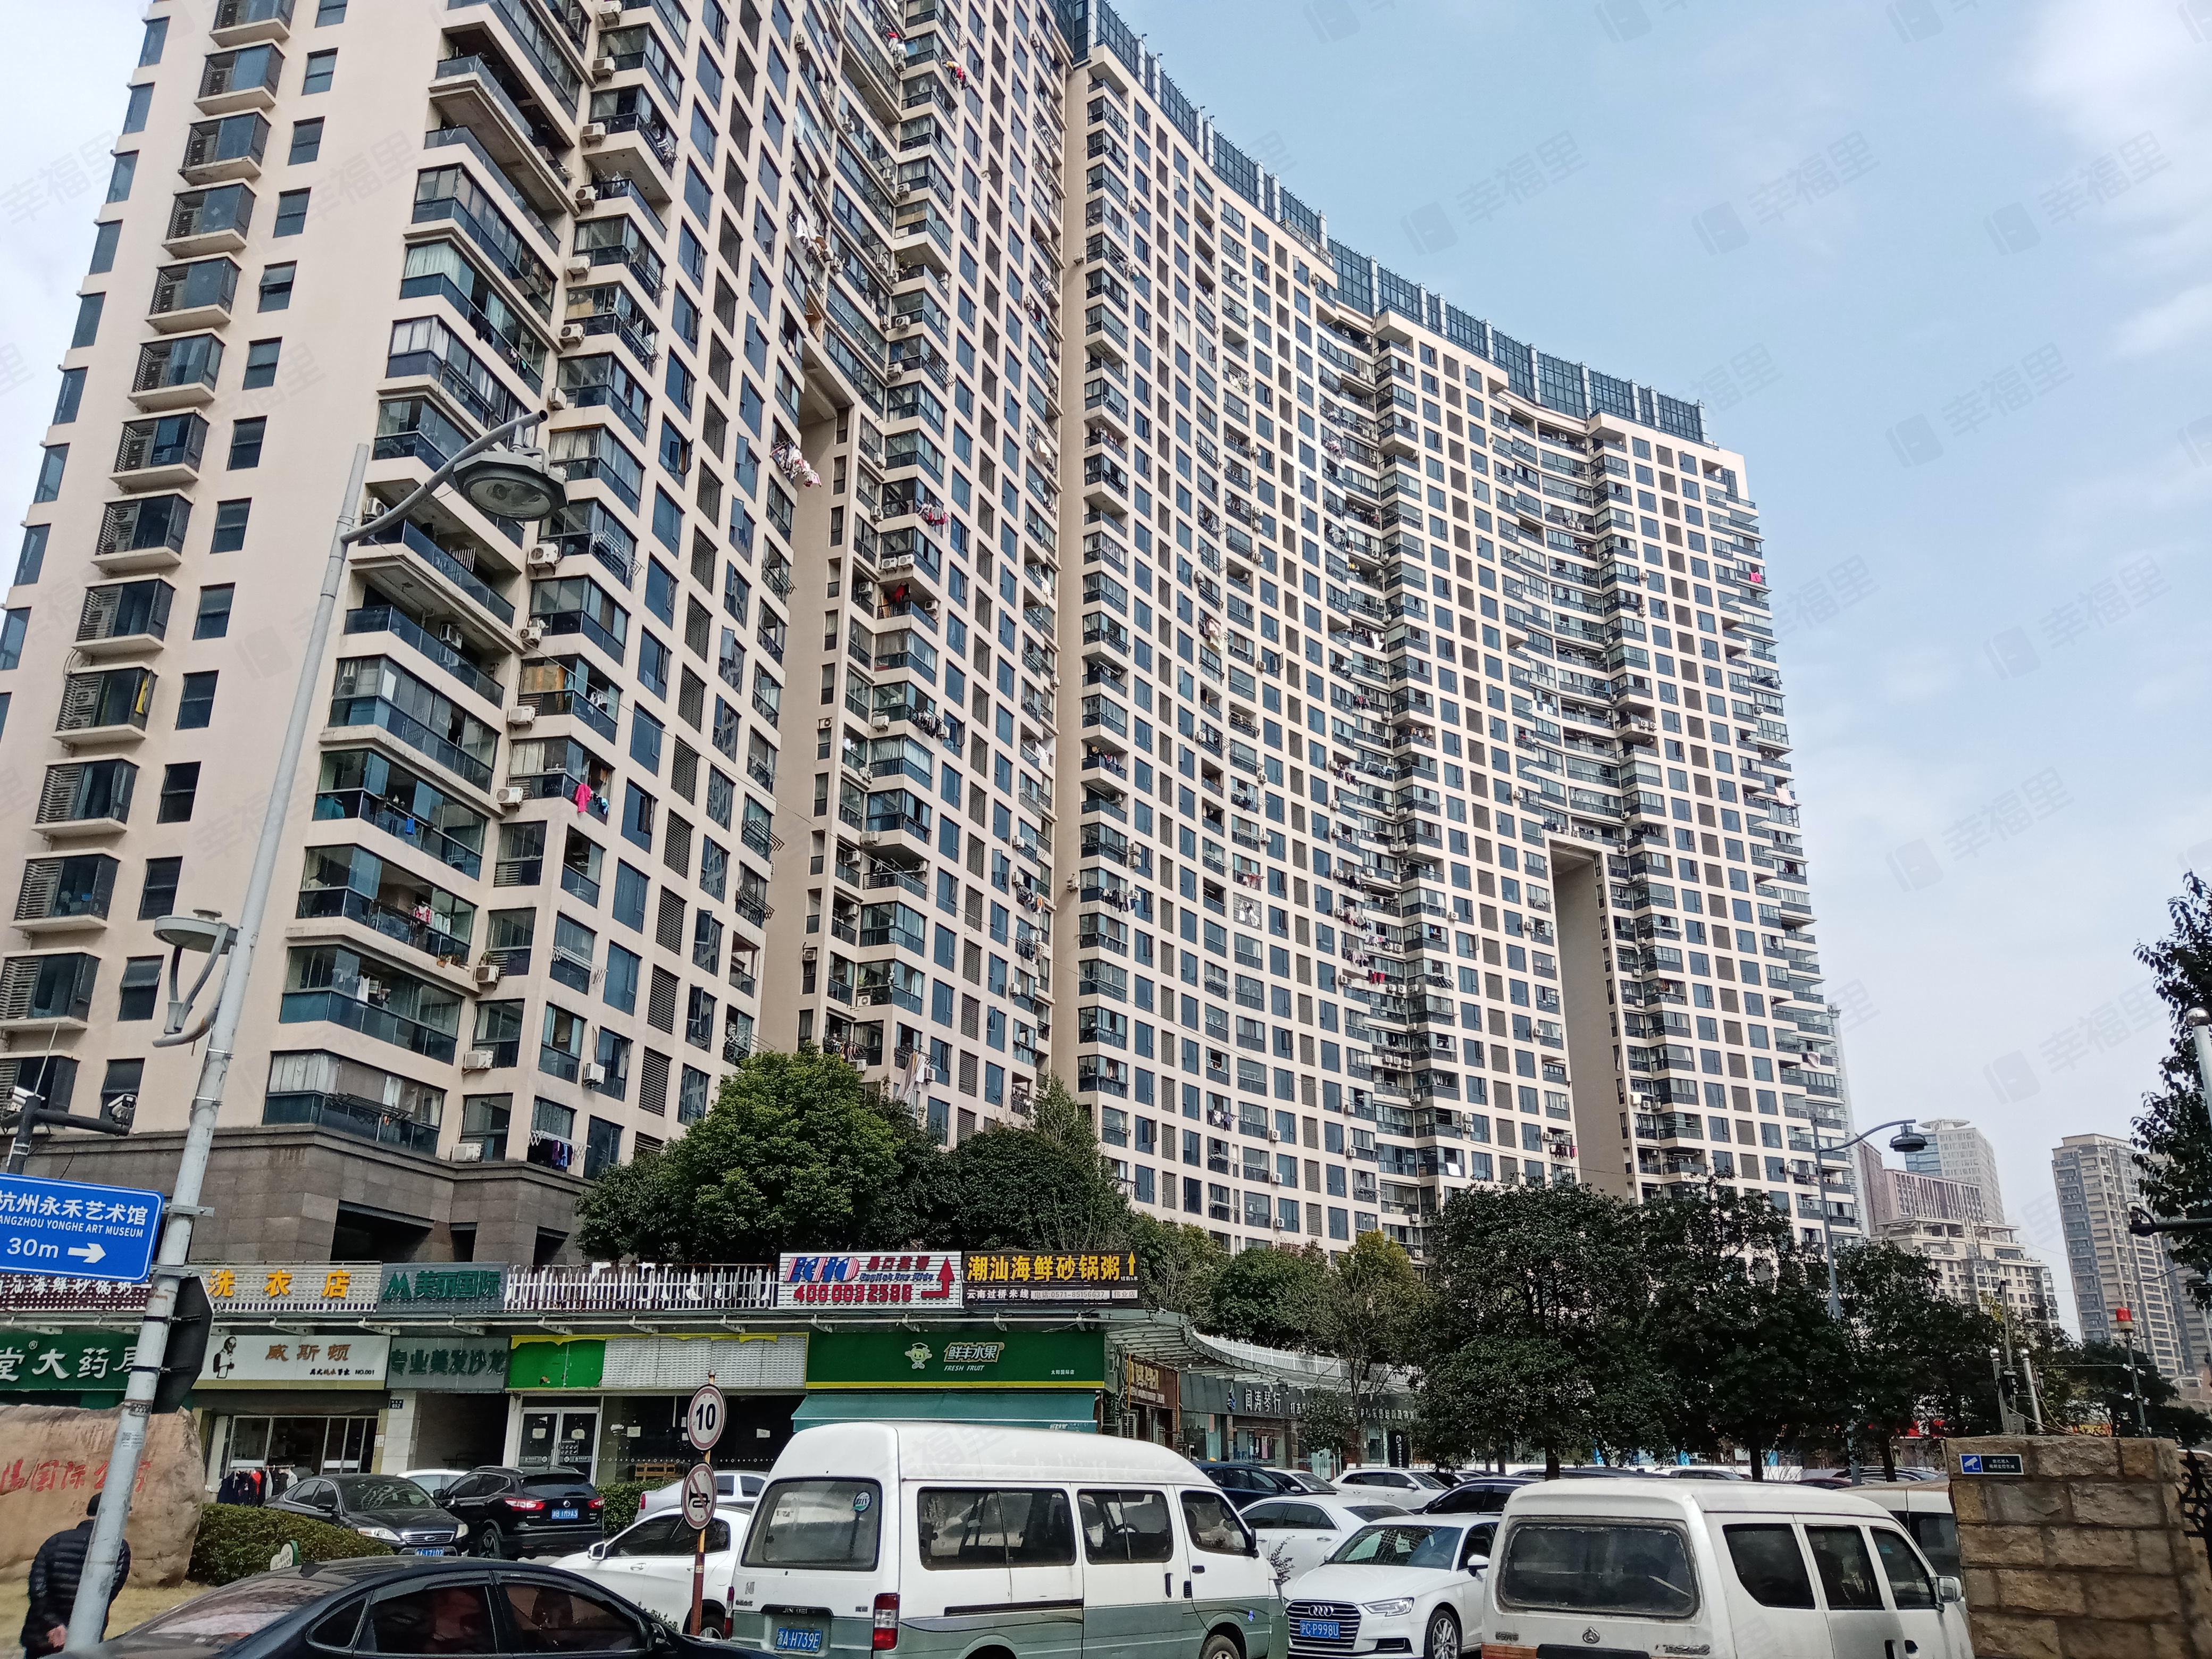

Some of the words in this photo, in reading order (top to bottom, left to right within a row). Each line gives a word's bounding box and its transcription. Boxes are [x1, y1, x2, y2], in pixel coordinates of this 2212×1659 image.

[0, 1190, 148, 1226] 杭州永禾艺术馆
[46, 1219, 84, 1232] YONGHE
[86, 1224, 104, 1234] ART
[105, 1225, 144, 1238] MUSEUM
[7, 1237, 59, 1258] 30m
[859, 1273, 894, 1283] English
[912, 1272, 934, 1281] Kids
[967, 1254, 1120, 1281] 潮汕海鲜砂锅粥
[0, 1276, 132, 1296] 汕海鲜砂锅粥
[208, 1269, 350, 1298] 洗衣店
[415, 1270, 501, 1298] 美丽国际
[966, 1289, 1030, 1300] 云南过桥米线
[265, 1344, 351, 1362] 威斯顿
[391, 1348, 506, 1376] 专业美发沙龙
[947, 1345, 998, 1360] 鲜丰水果
[696, 1403, 716, 1430] 10
